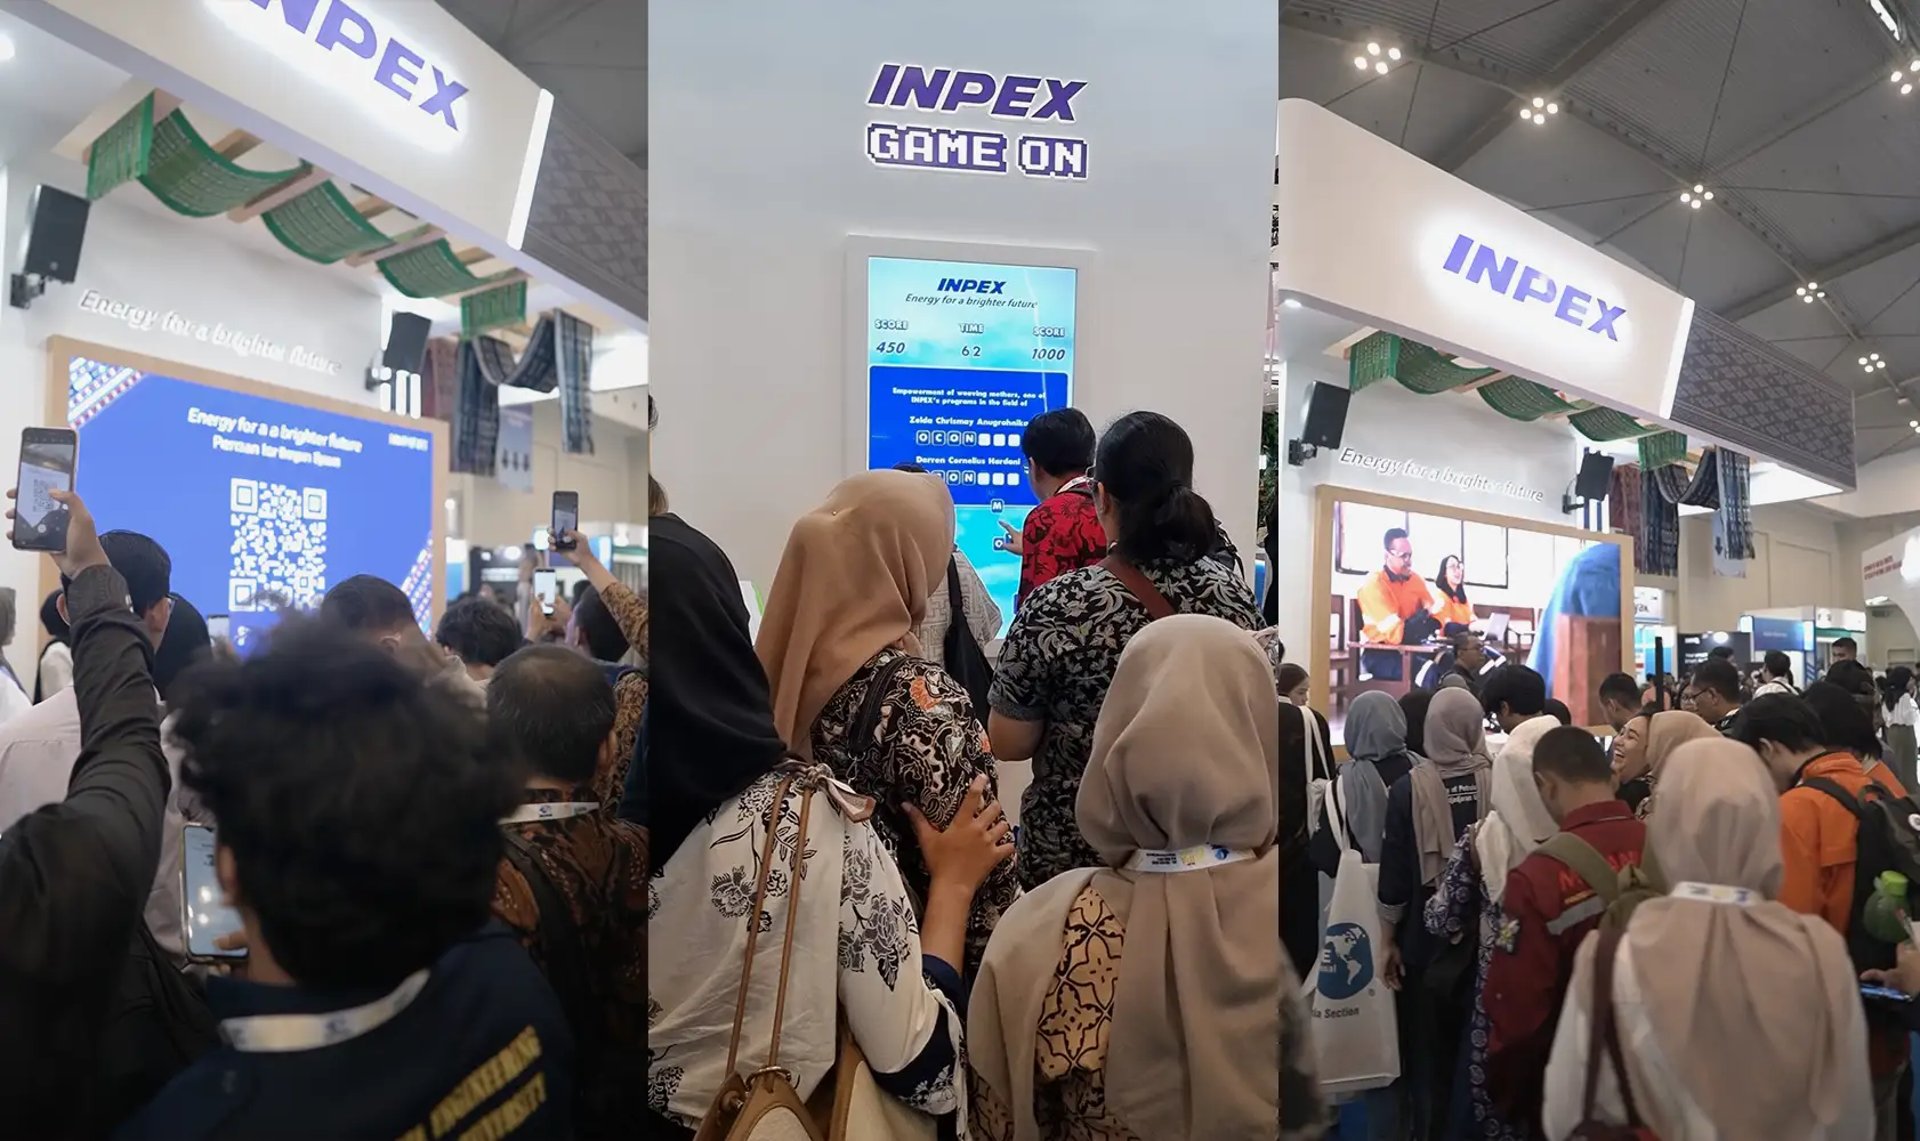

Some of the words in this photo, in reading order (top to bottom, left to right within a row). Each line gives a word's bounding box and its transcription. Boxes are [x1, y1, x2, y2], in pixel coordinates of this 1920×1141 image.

[866, 64, 1088, 121] INPEX
[868, 125, 1006, 172] GAME
[1018, 136, 1087, 178] ON
[937, 277, 1006, 295] INPEX
[1443, 233, 1626, 342] INPEX
[905, 293, 940, 306] Energy
[941, 294, 957, 305] for
[966, 295, 1006, 309] brighter
[1007, 299, 1038, 309] future
[79, 288, 160, 332] Energy
[874, 318, 909, 331] SCORE
[958, 322, 985, 334] TIME
[1032, 326, 1066, 338] SCORE
[876, 341, 906, 354] 450
[1031, 348, 1066, 361] 1000
[892, 387, 945, 397] Empowerment
[946, 388, 955, 396] of
[957, 389, 987, 398] weaving
[911, 396, 940, 405] INPEX's
[941, 397, 978, 406] programs
[1002, 399, 1018, 407] field
[1019, 399, 1028, 407] of
[187, 406, 237, 433] Energy
[237, 415, 259, 434] for
[257, 423, 269, 437] a
[269, 425, 281, 439] a
[915, 455, 946, 465] Darren
[948, 456, 986, 465] Cornelius
[1339, 446, 1402, 477] Energy
[1430, 469, 1440, 481] a
[1503, 480, 1545, 503] future
[1324, 1007, 1359, 1019] Section
